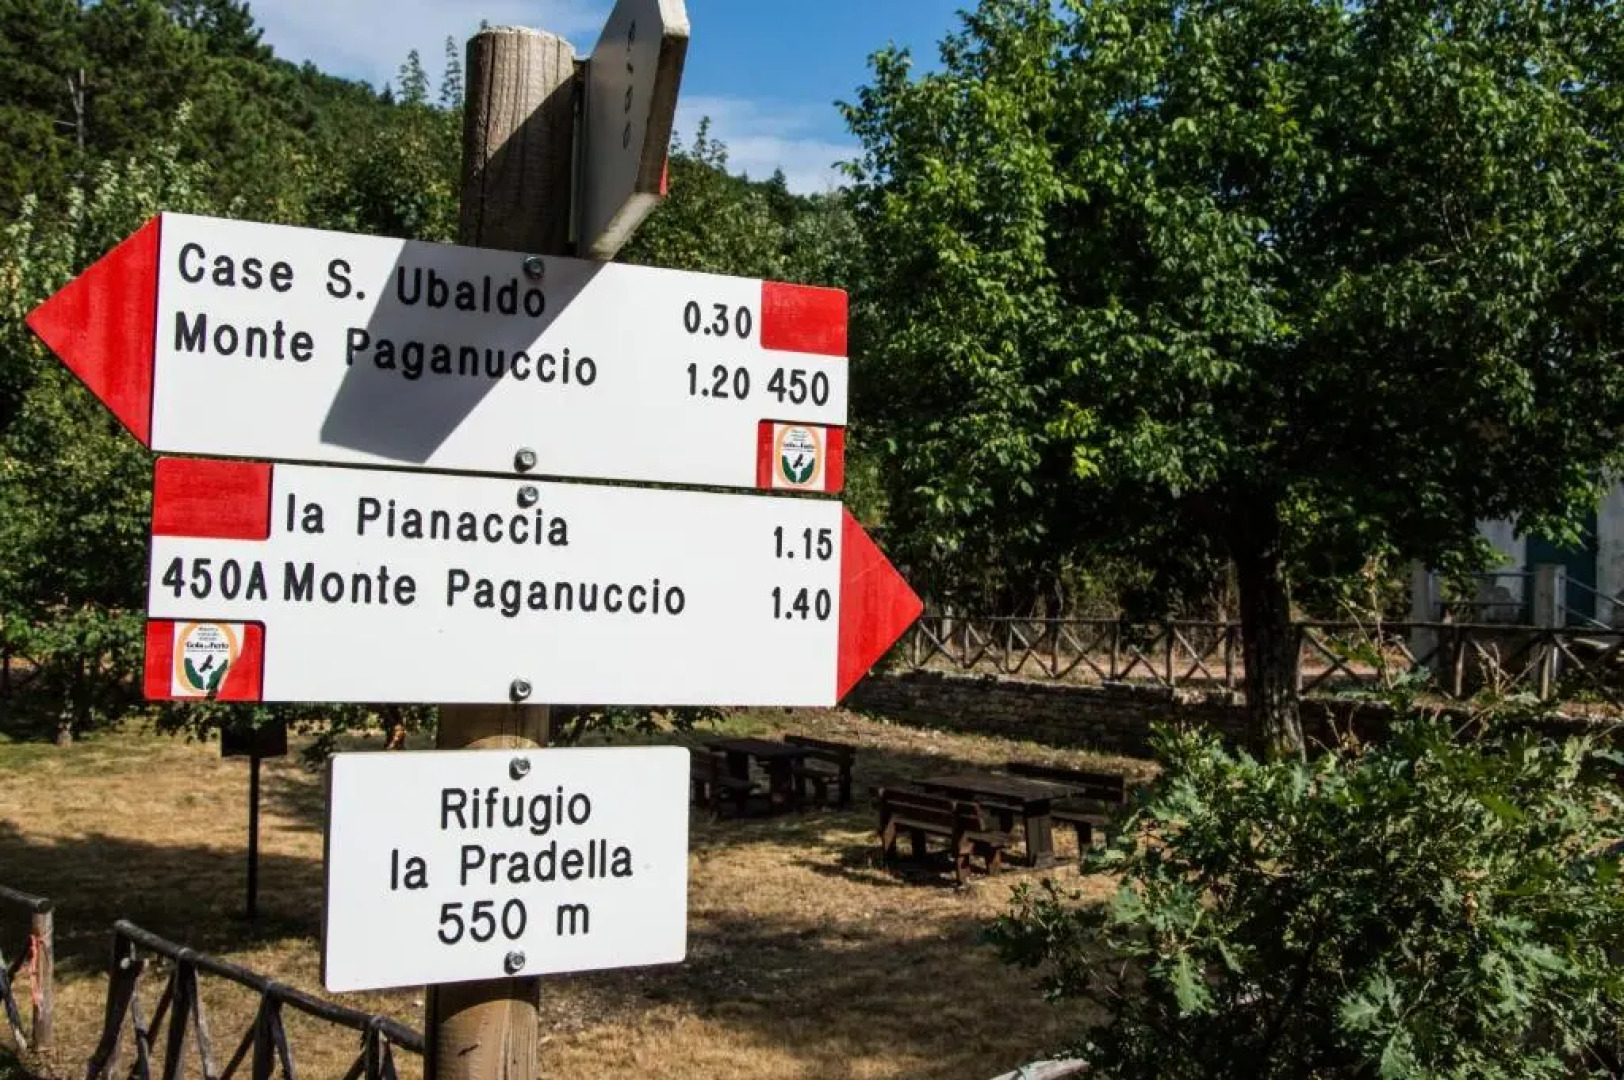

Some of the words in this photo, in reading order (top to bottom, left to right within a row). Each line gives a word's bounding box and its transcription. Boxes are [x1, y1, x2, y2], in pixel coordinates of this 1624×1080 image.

[179, 243, 293, 292] Case
[327, 259, 365, 300] S.
[397, 266, 545, 317] Ubaldo
[684, 301, 752, 339] 0.30
[175, 311, 314, 362] Monte
[346, 328, 596, 386] Paganuccio
[688, 363, 750, 400] 1.20
[767, 368, 829, 406] 450
[287, 493, 324, 533] la
[357, 497, 568, 546] Pianaccia
[774, 526, 832, 560] 1.15
[162, 557, 267, 601] 450A
[284, 561, 416, 606] Monte
[447, 569, 685, 617] Paganuccio
[772, 587, 831, 620] 1.40
[441, 786, 591, 836] Rifugio
[391, 849, 428, 890] la
[460, 839, 633, 886] Pradella
[438, 899, 527, 945] 550
[557, 904, 589, 936] m
